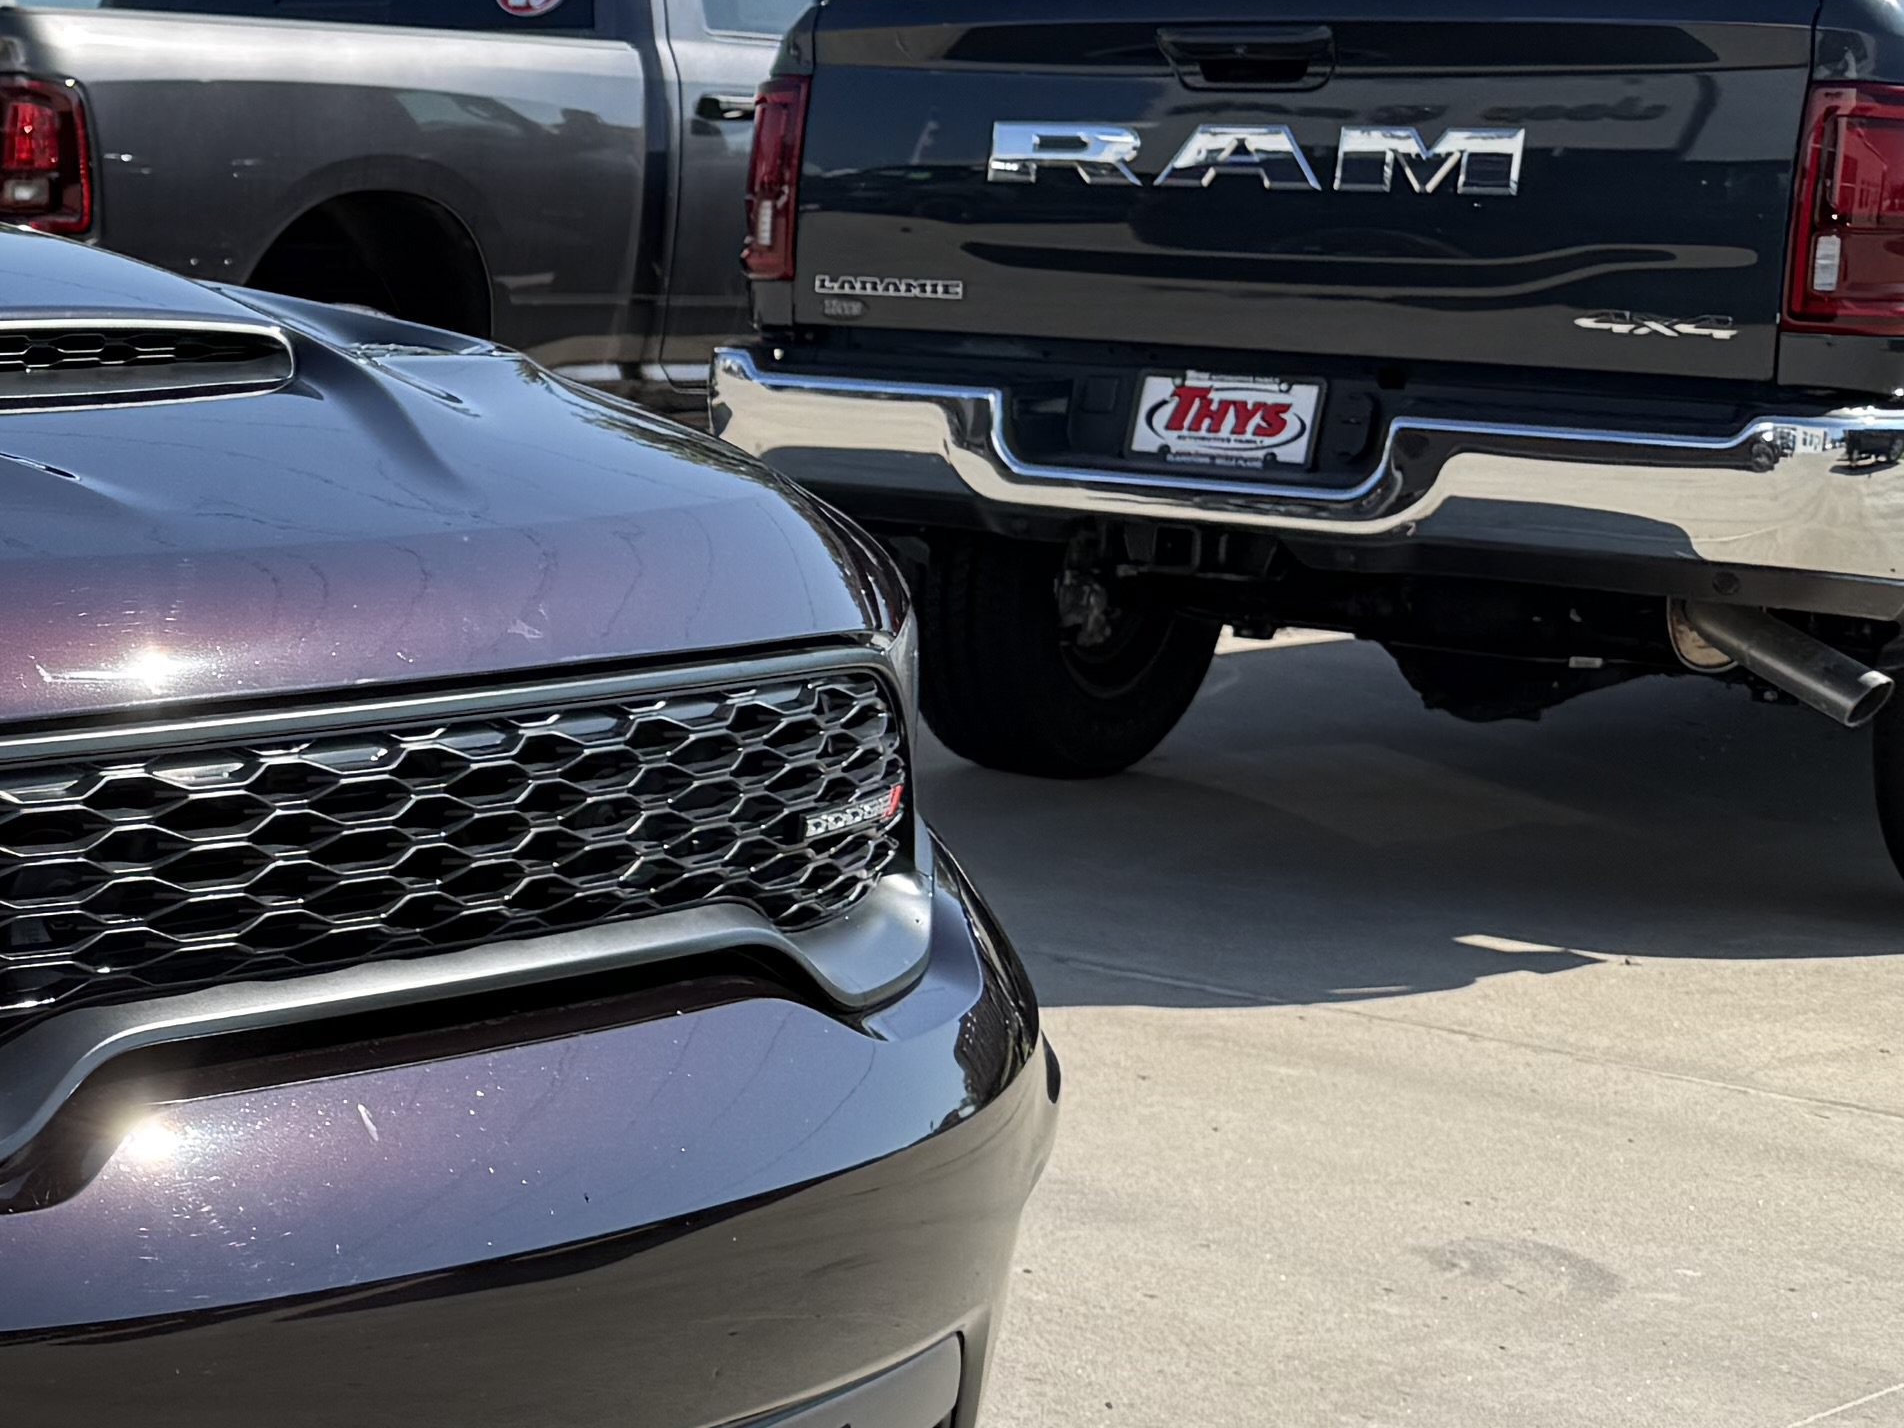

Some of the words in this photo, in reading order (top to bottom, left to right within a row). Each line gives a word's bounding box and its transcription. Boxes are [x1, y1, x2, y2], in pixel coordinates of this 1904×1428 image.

[987, 121, 1526, 196] RAM
[815, 274, 963, 300] LARAMIE
[1164, 385, 1293, 439] THYS
